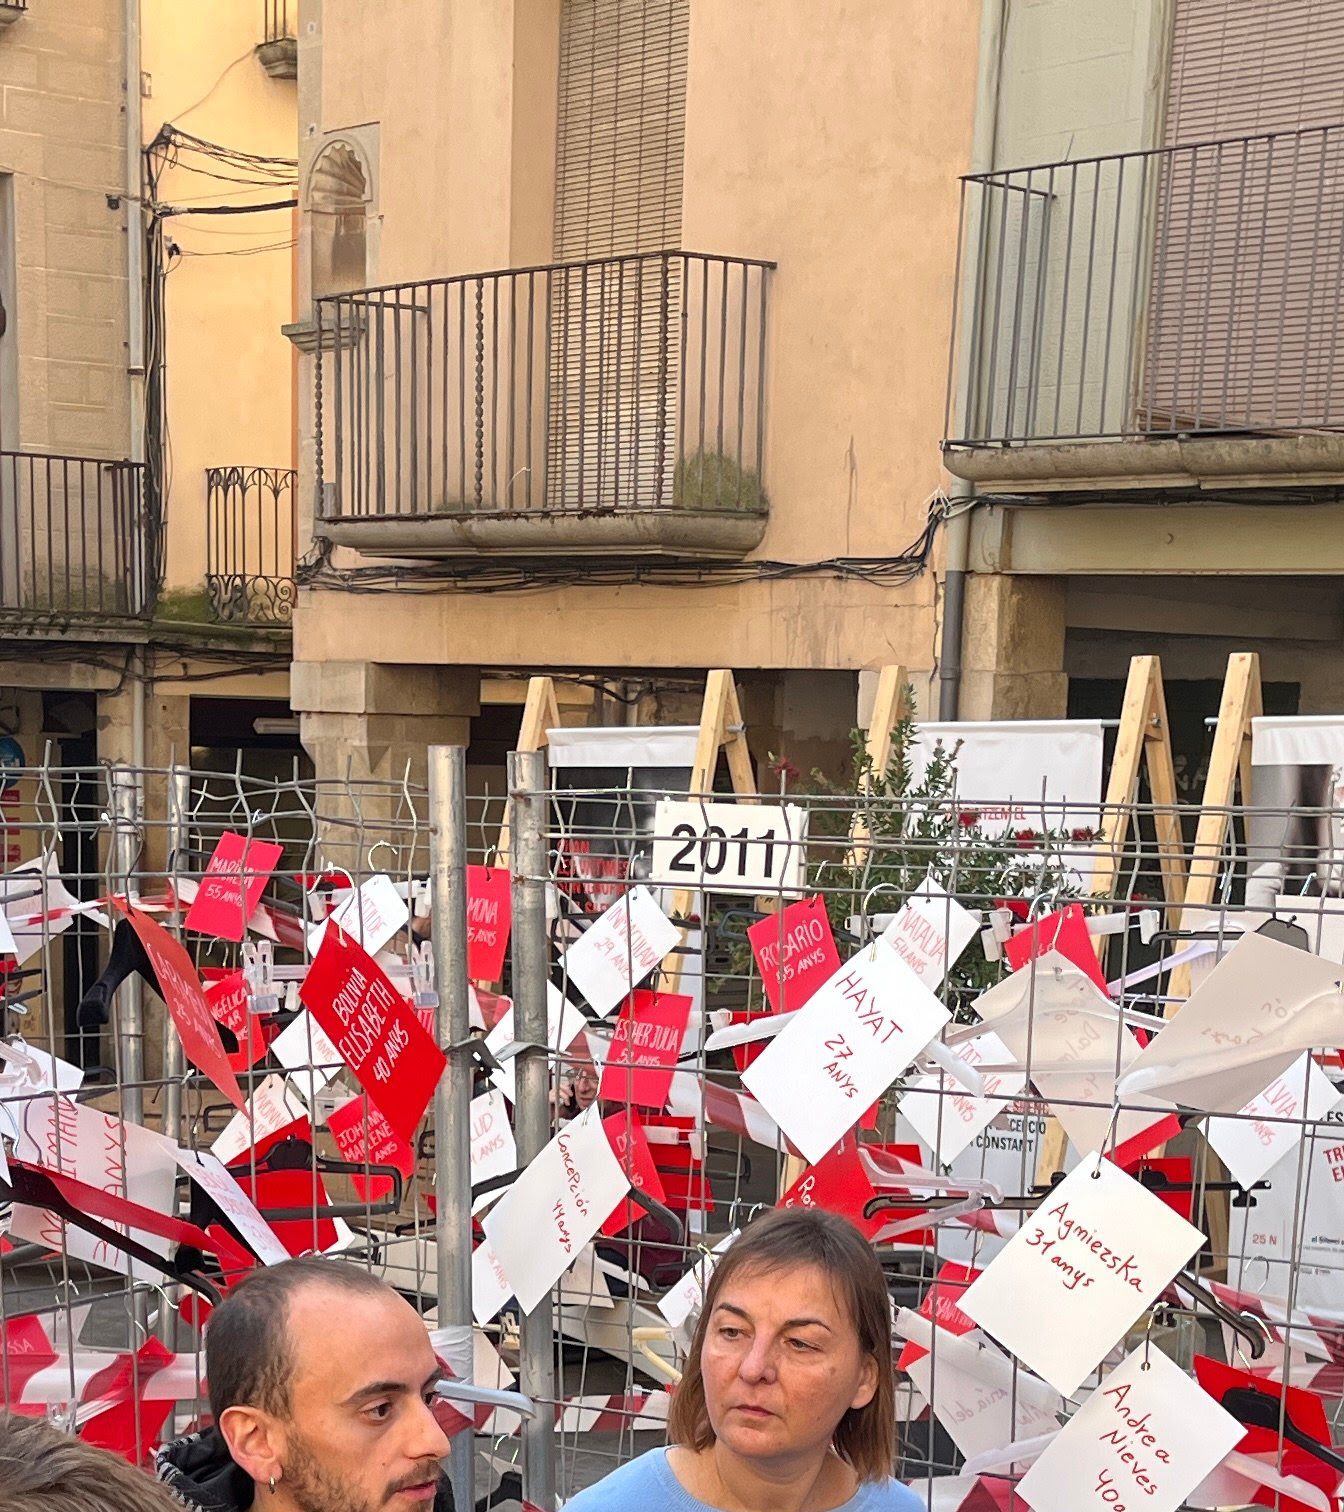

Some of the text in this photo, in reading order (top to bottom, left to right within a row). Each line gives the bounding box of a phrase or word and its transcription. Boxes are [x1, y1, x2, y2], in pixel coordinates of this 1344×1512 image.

[669, 823, 776, 878] 2011
[797, 949, 827, 975] ANYS
[834, 971, 904, 1044] HAYAT
[371, 1019, 410, 1084] 40 ANYS
[824, 1033, 854, 1061] 27
[823, 1061, 859, 1100] ANYS
[1252, 1233, 1267, 1246] 25
[1050, 1255, 1095, 1291] anys
[1103, 1383, 1172, 1465] Andrea
[1099, 1429, 1159, 1497] Nieves
